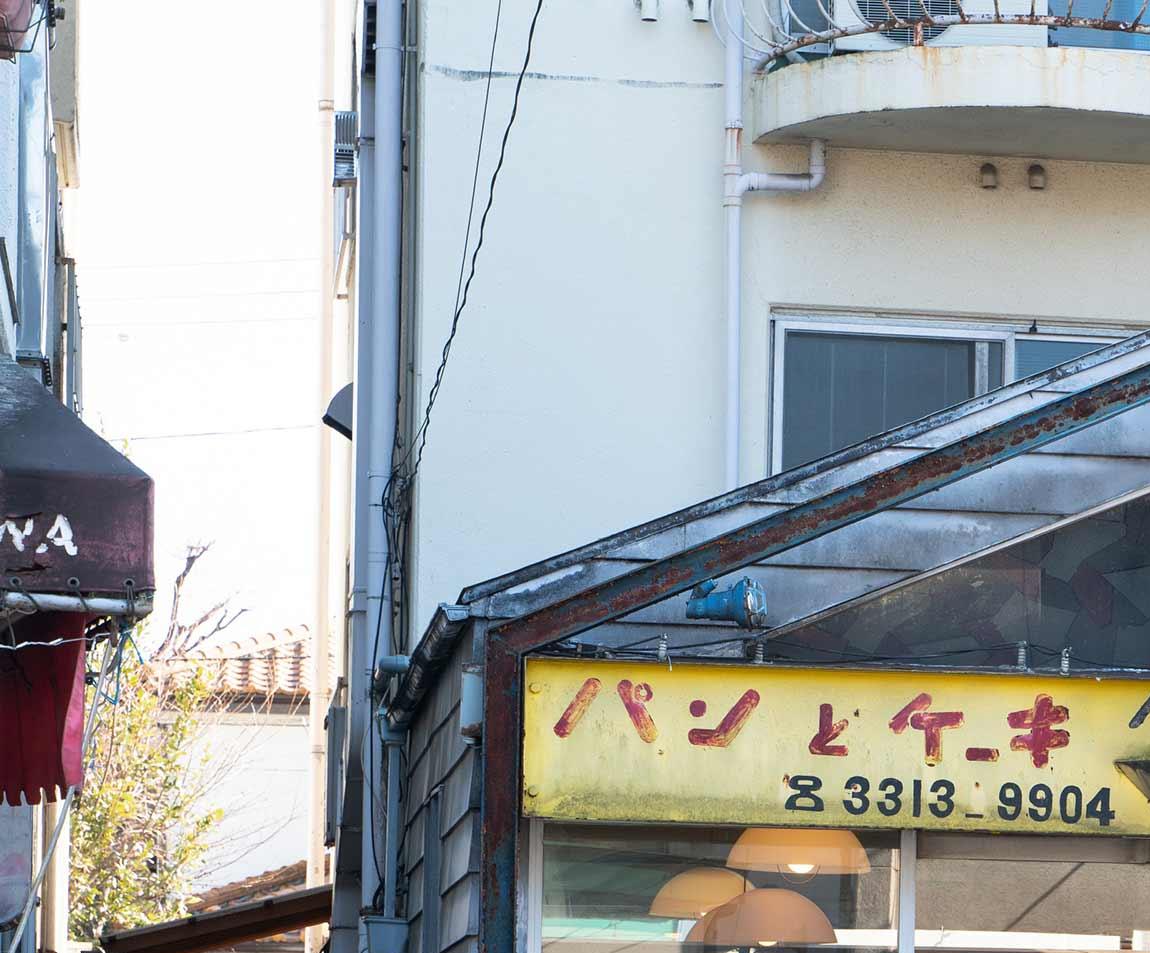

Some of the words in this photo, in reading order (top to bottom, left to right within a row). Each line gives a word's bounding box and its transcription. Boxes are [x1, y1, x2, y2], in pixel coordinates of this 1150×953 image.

[553, 677, 1071, 768] パンとケーキ
